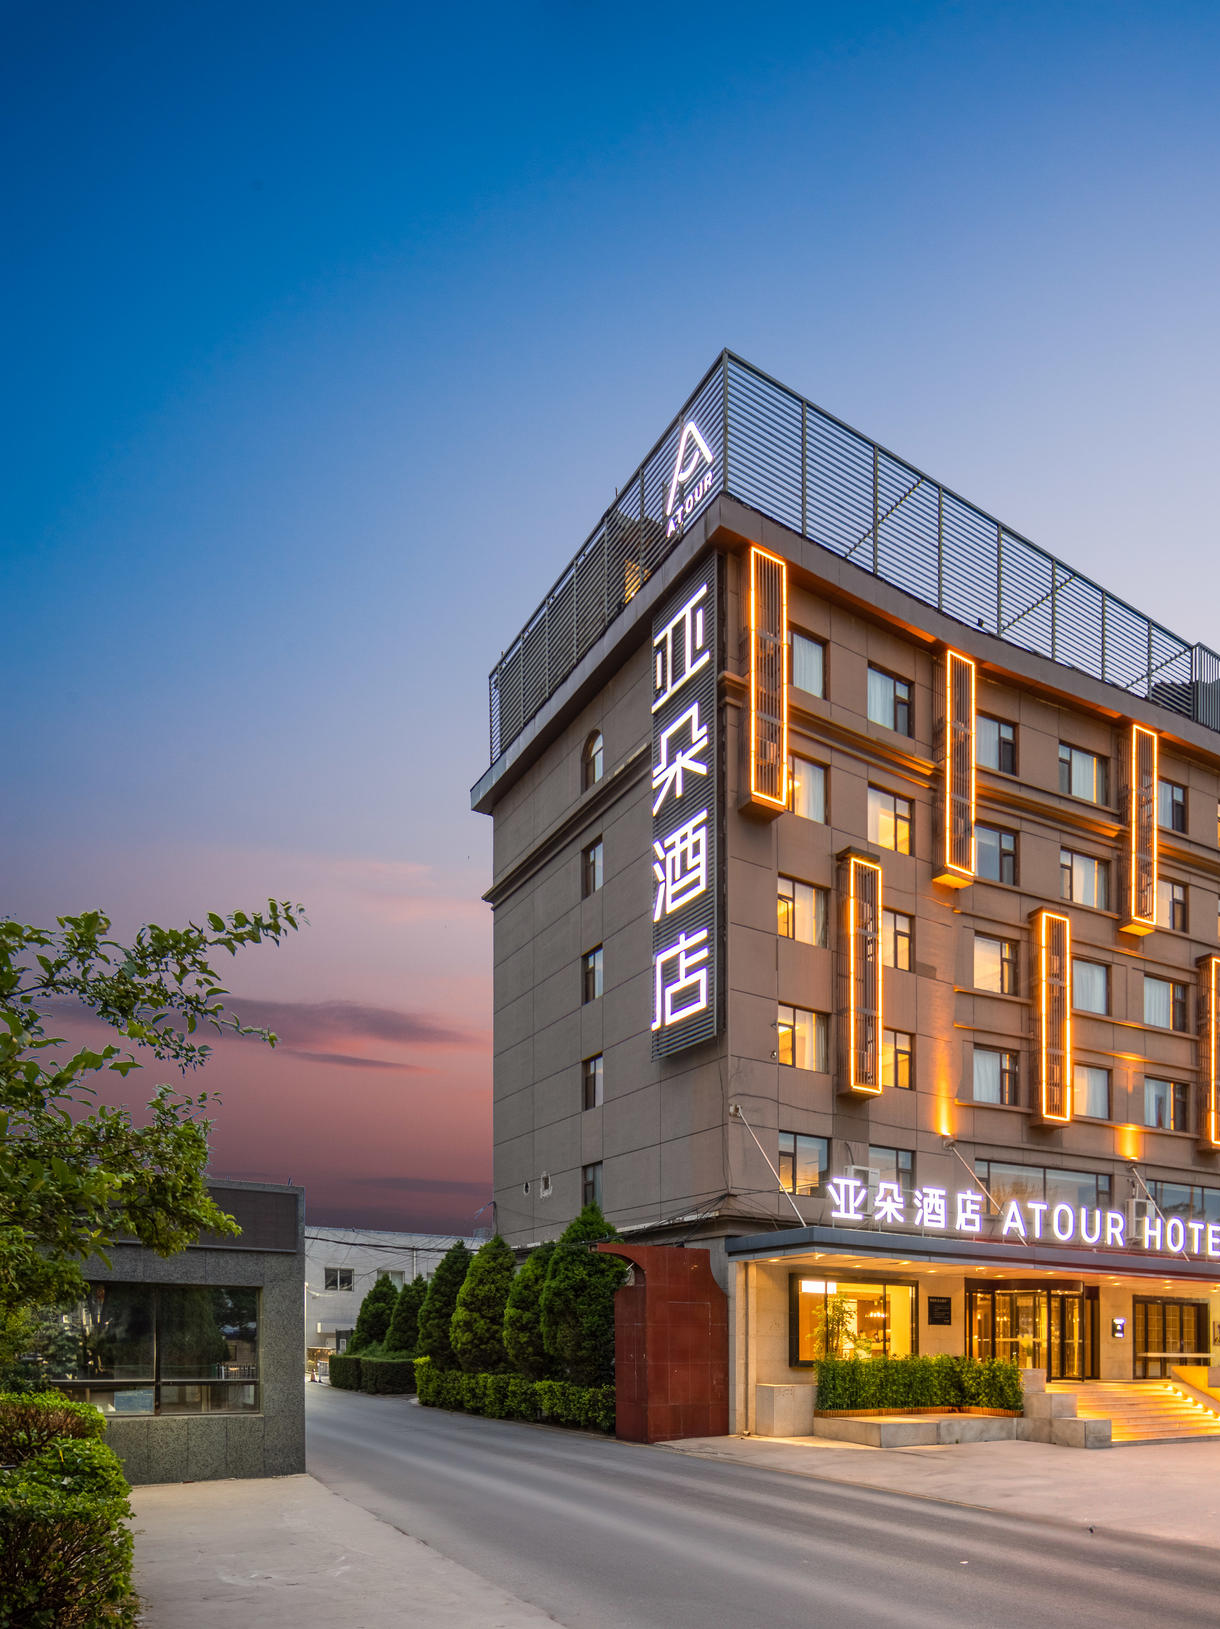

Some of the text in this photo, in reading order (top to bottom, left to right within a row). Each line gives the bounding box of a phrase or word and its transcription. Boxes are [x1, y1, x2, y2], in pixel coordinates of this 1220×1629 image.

[666, 470, 714, 538] ATOUR
[651, 583, 710, 1032] 亚朵酒店
[827, 1177, 983, 1233] 亚朵酒店
[1001, 1200, 1125, 1247] ATOUR
